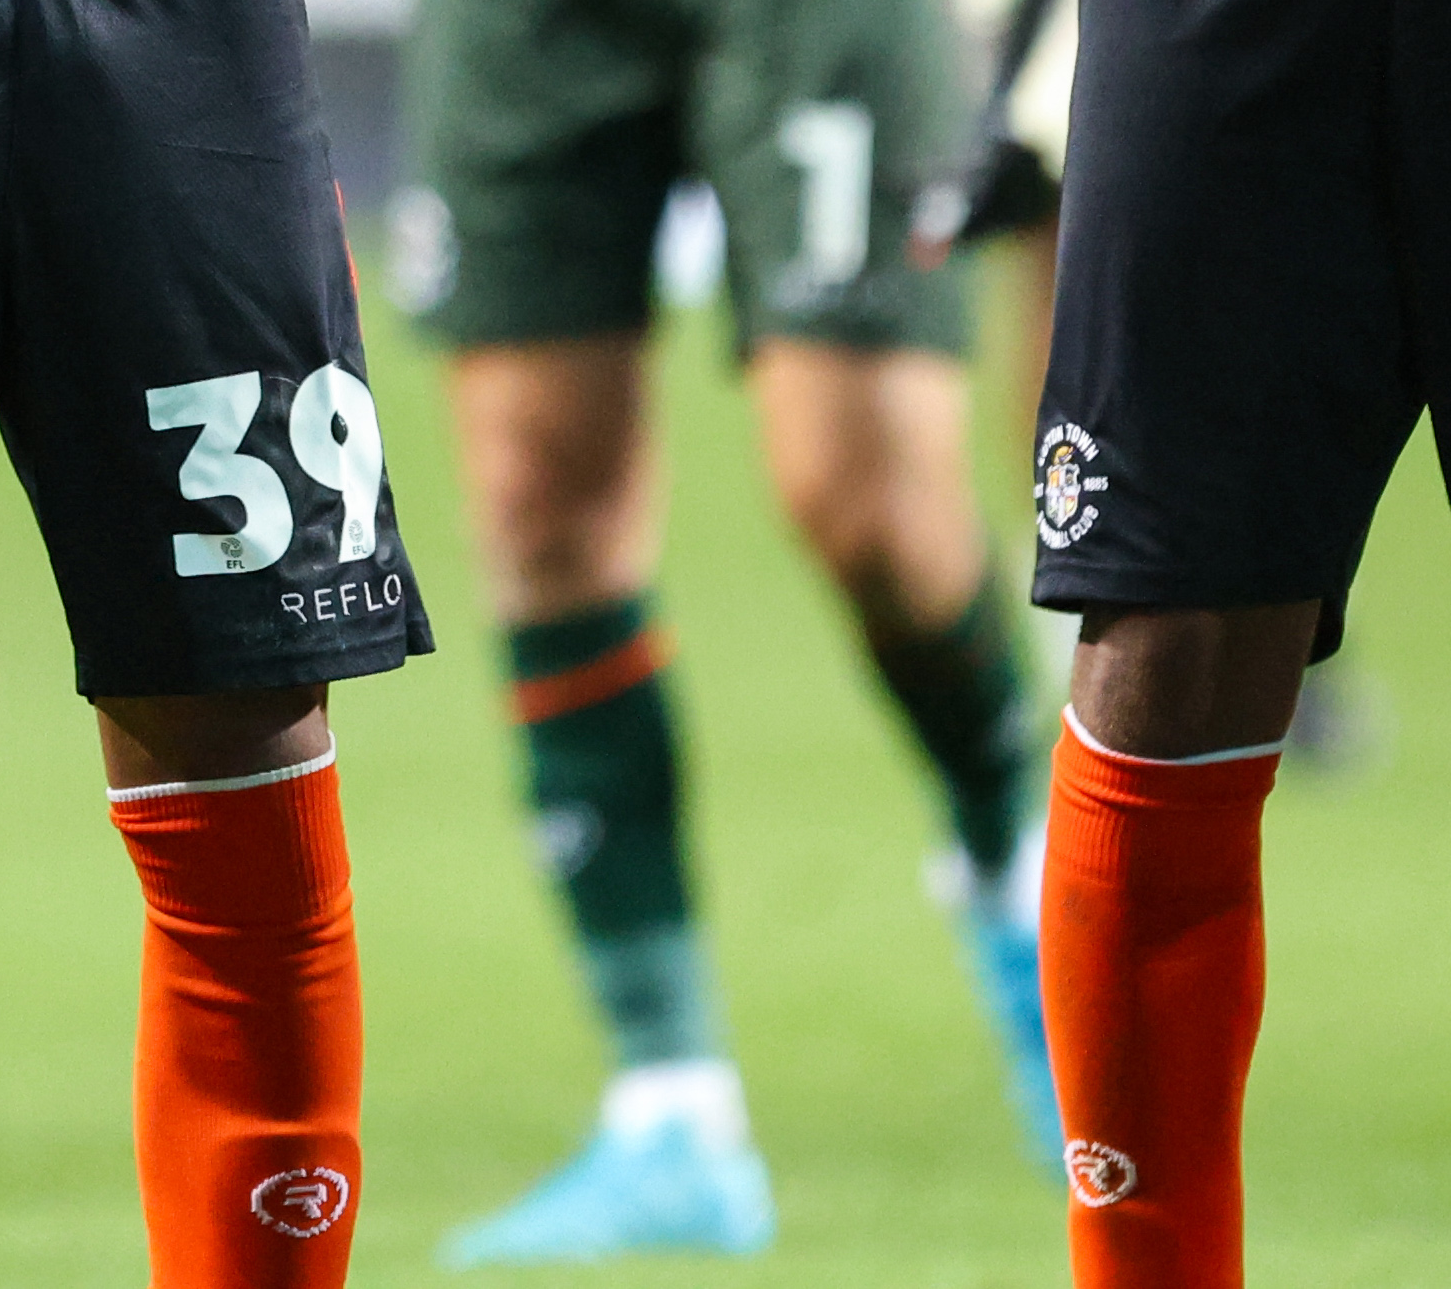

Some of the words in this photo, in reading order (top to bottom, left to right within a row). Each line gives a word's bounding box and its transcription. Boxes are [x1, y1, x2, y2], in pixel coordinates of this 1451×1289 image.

[1065, 422, 1099, 462] TOWN
[145, 359, 384, 578] 39
[226, 559, 245, 569] EFL
[280, 573, 401, 624] REFLO
